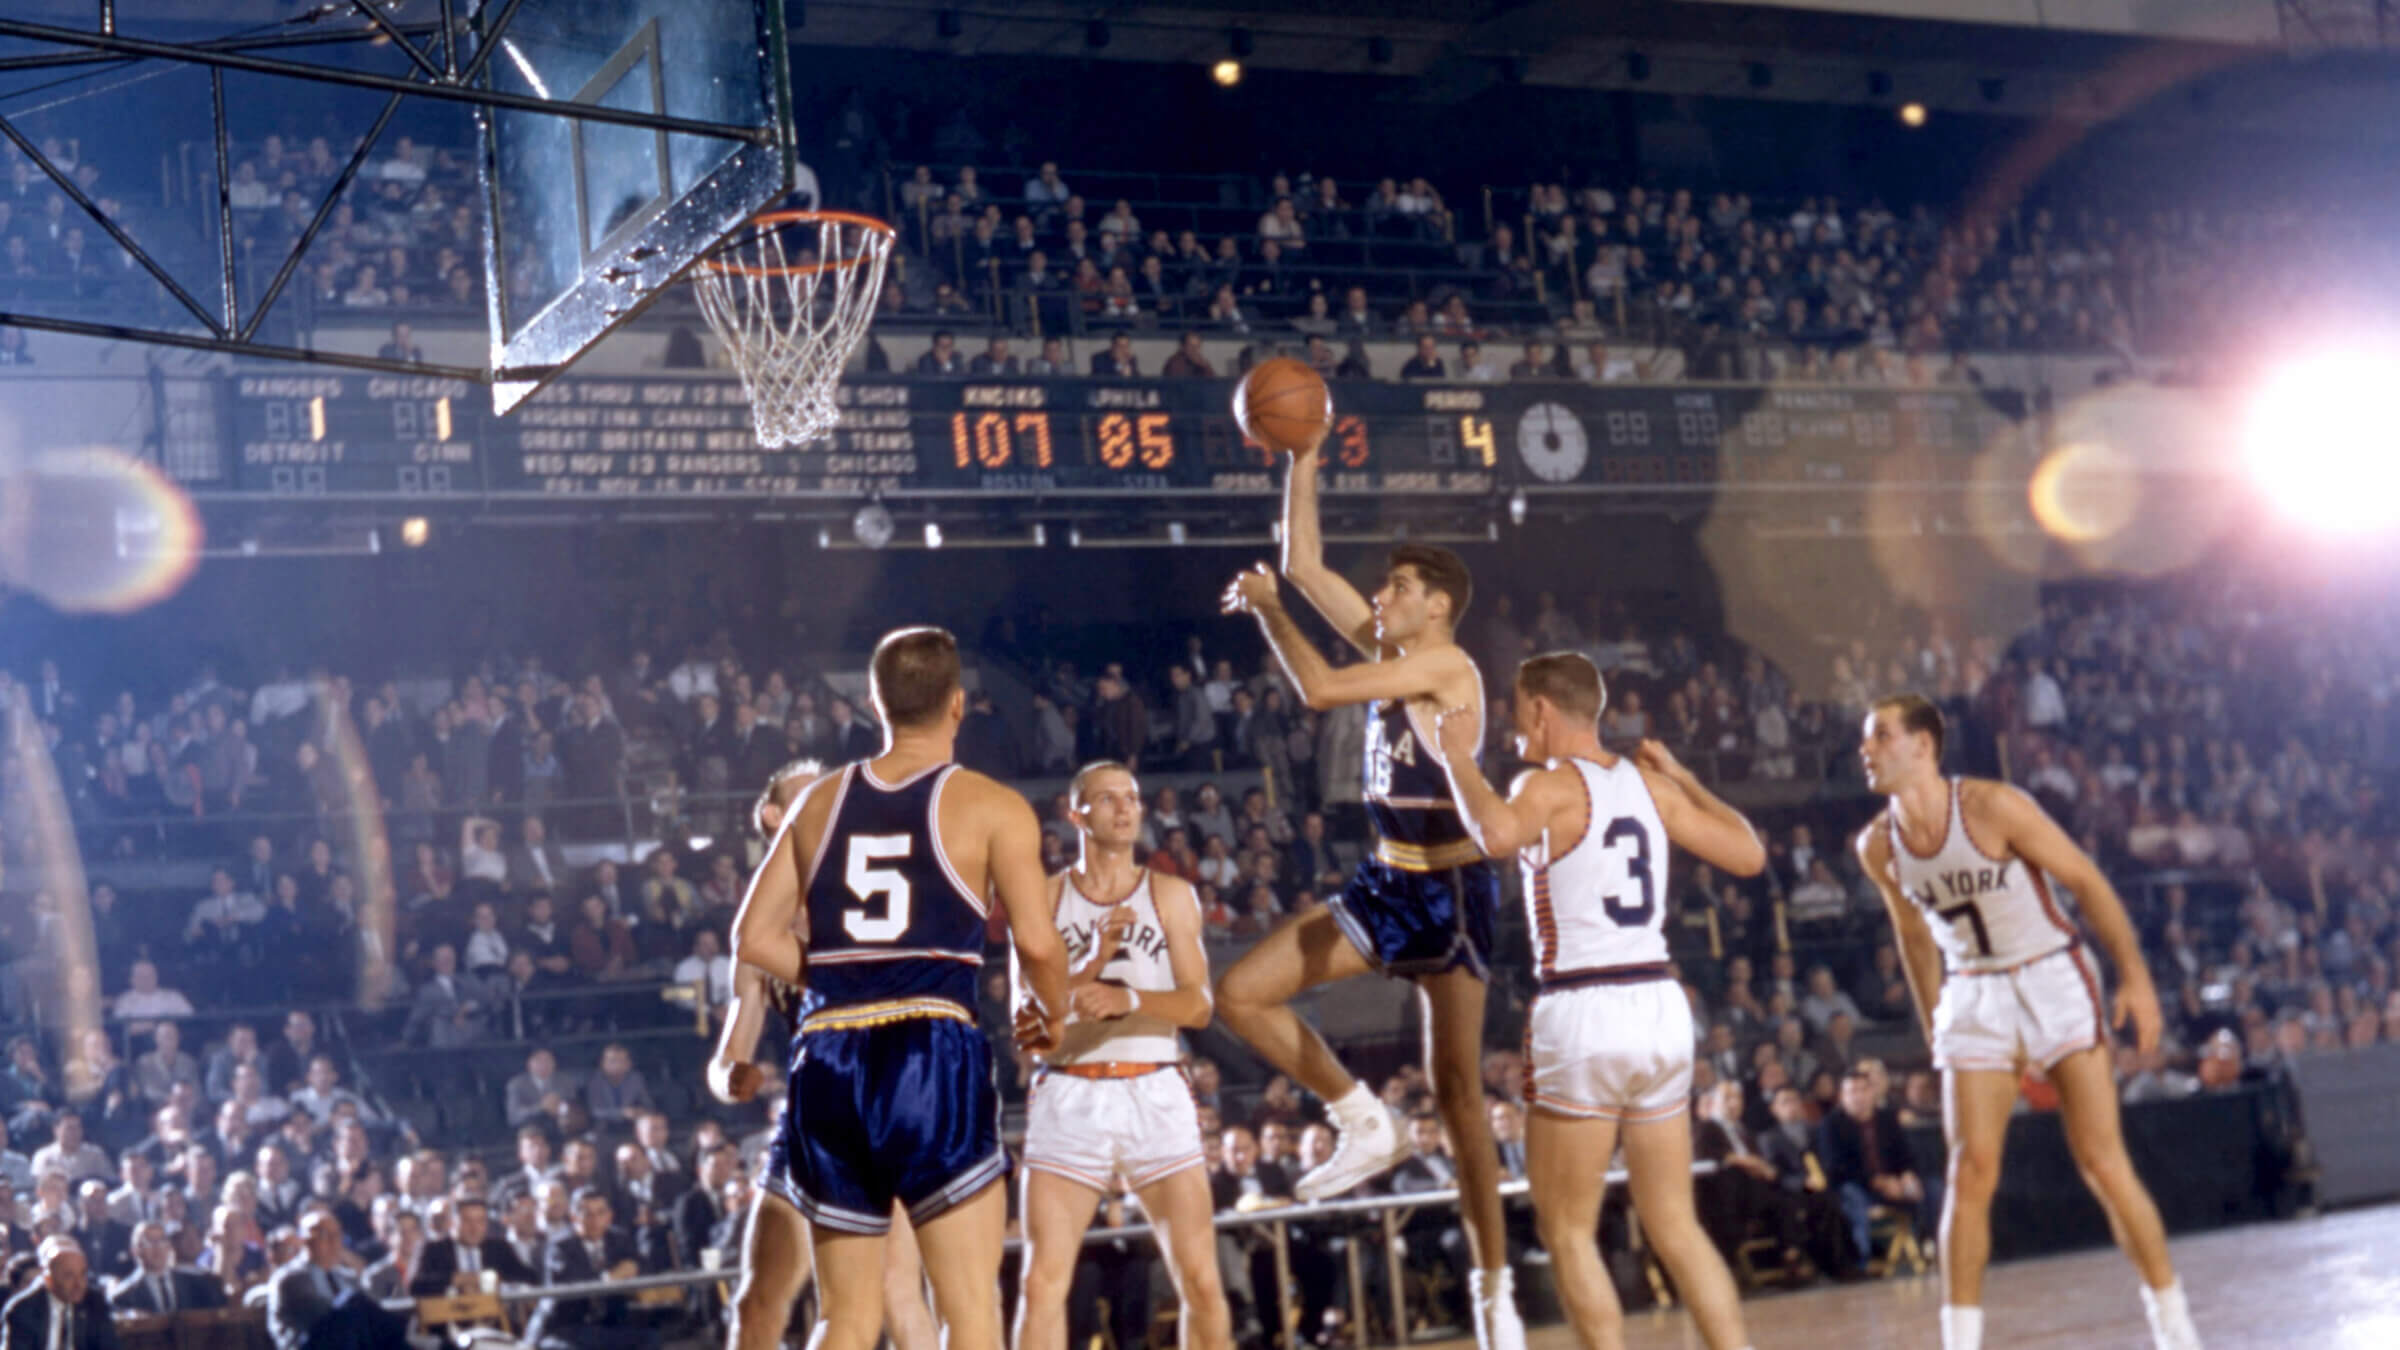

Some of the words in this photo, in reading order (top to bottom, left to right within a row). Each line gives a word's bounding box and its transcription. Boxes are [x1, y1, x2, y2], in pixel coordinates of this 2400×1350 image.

[240, 378, 342, 398] RANGERS
[367, 378, 468, 399] CHICAGO
[642, 385, 685, 405] NOV
[857, 386, 909, 406] SHOW
[519, 408, 640, 427] ARGENTINA
[651, 408, 732, 428] CANADA
[520, 431, 588, 450] GREAT
[600, 430, 696, 450] BRITAIN
[849, 432, 914, 451] TEAMS
[952, 412, 1053, 469] 107
[1097, 412, 1174, 469] 85
[1459, 414, 1498, 468] 4
[244, 442, 346, 463] DETROIT
[570, 455, 614, 475] NOV
[664, 454, 764, 474] RANGERS
[826, 454, 917, 474] CHICAGO
[1603, 816, 1655, 927] 3
[1938, 866, 2009, 898] YORK
[843, 834, 912, 942] 5
[1936, 901, 1991, 957] 7
